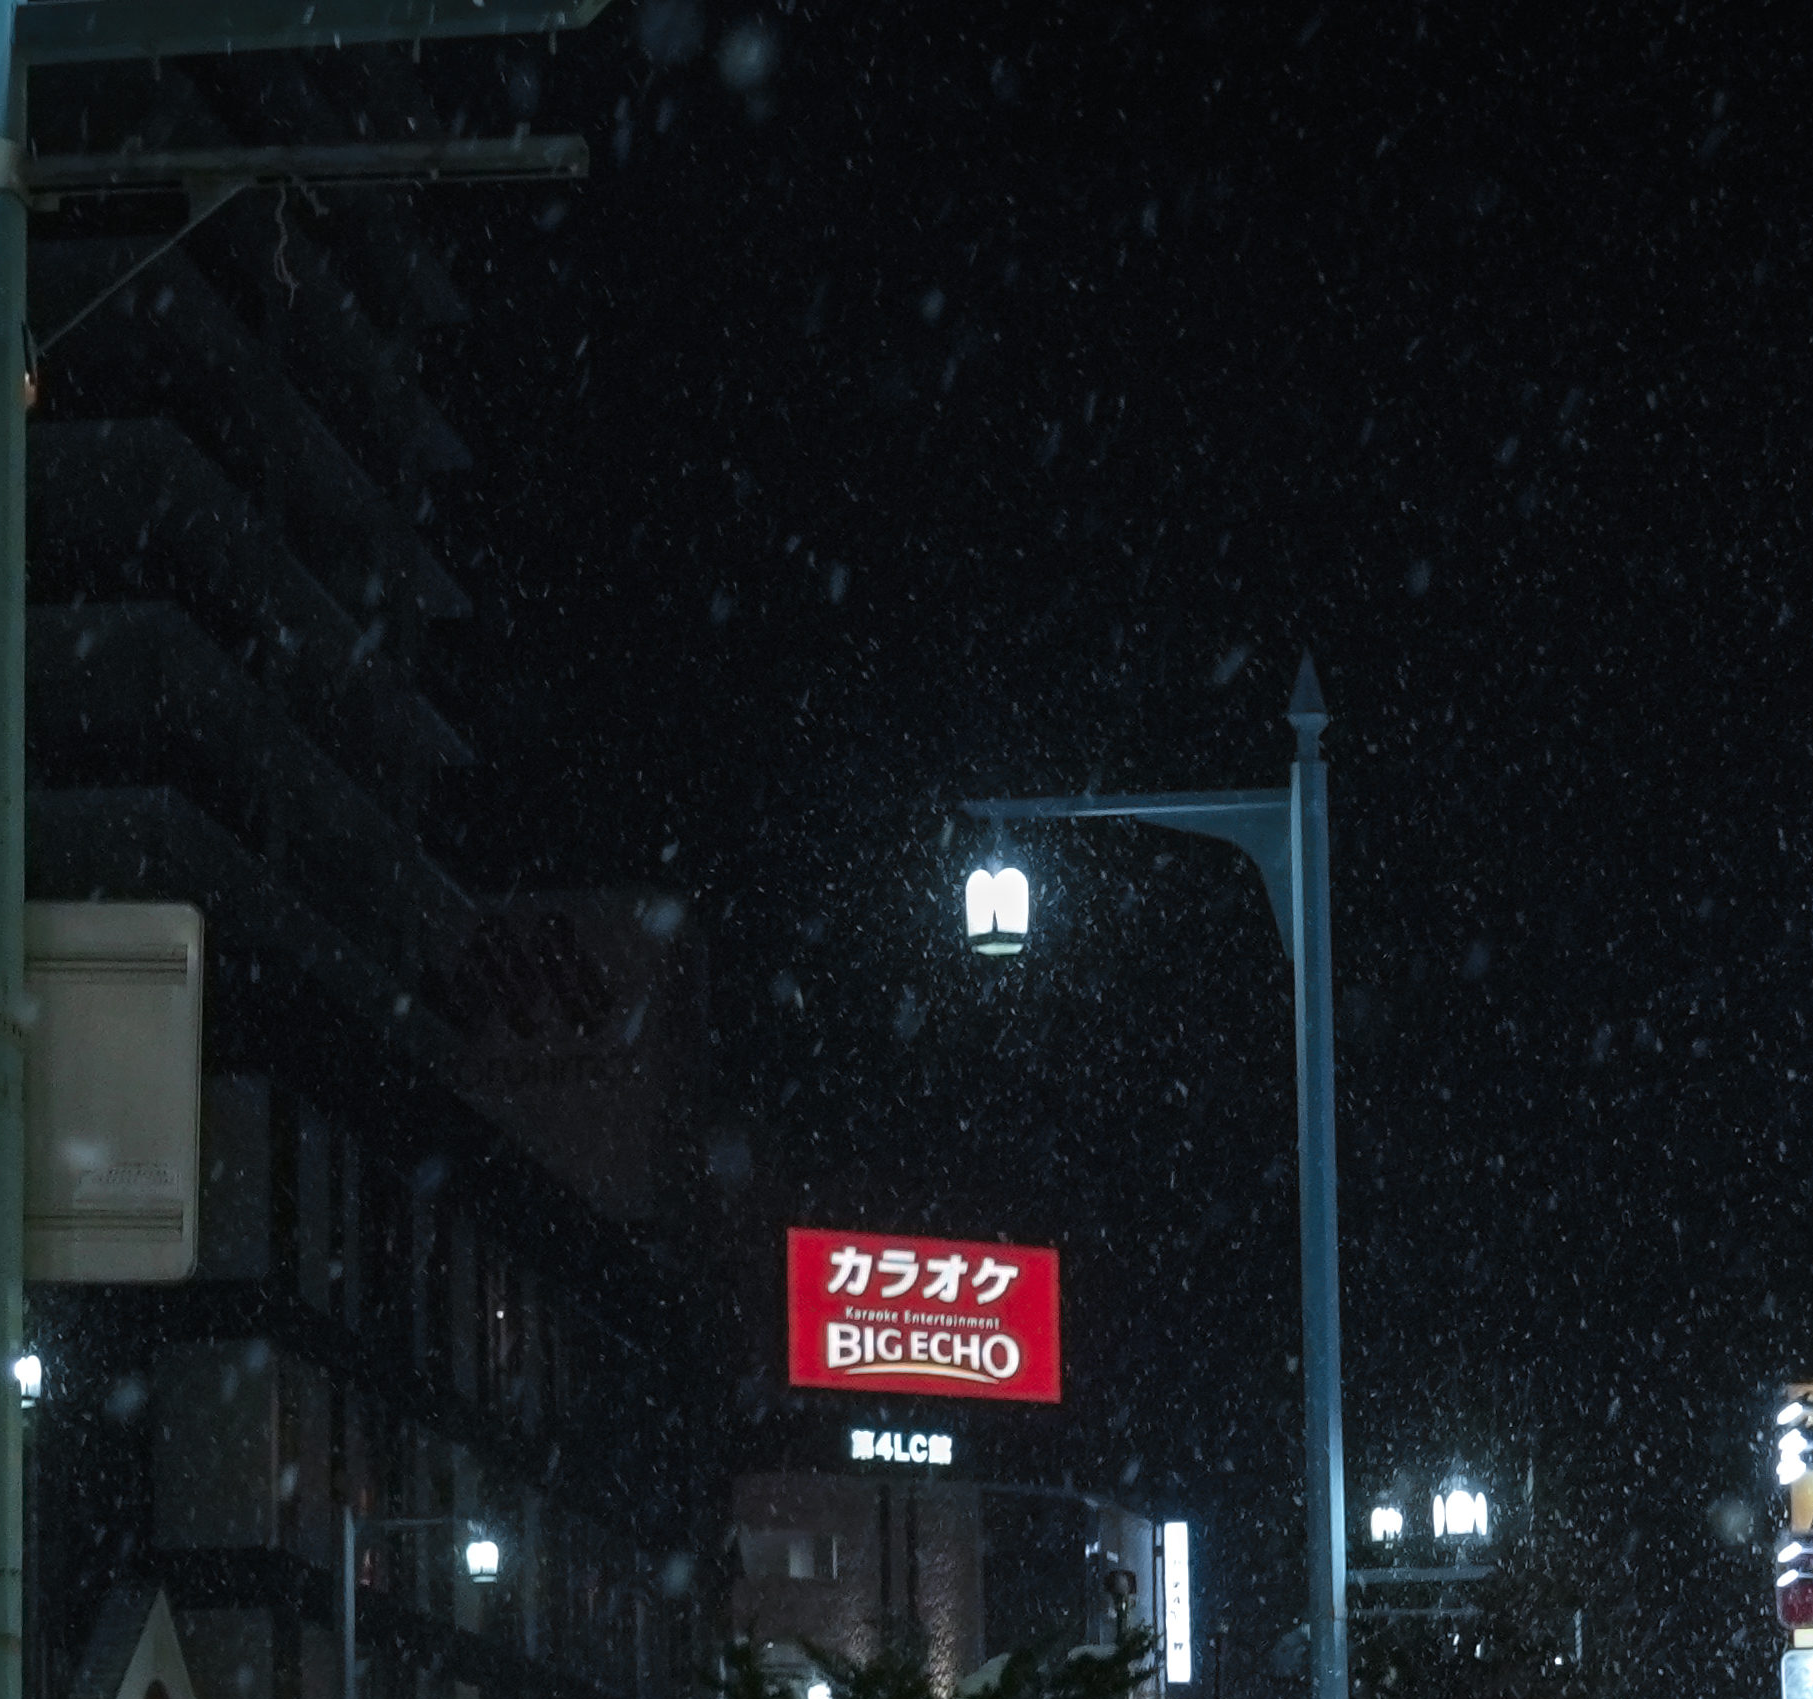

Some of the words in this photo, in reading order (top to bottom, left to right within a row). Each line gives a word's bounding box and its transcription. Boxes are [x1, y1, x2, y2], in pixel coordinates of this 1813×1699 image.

[827, 1247, 1019, 1305] カラオケ
[845, 1306, 899, 1324] Karaoke
[904, 1310, 1001, 1330] Entertainment
[827, 1322, 902, 1368] BIG
[910, 1332, 1020, 1379] ECHO
